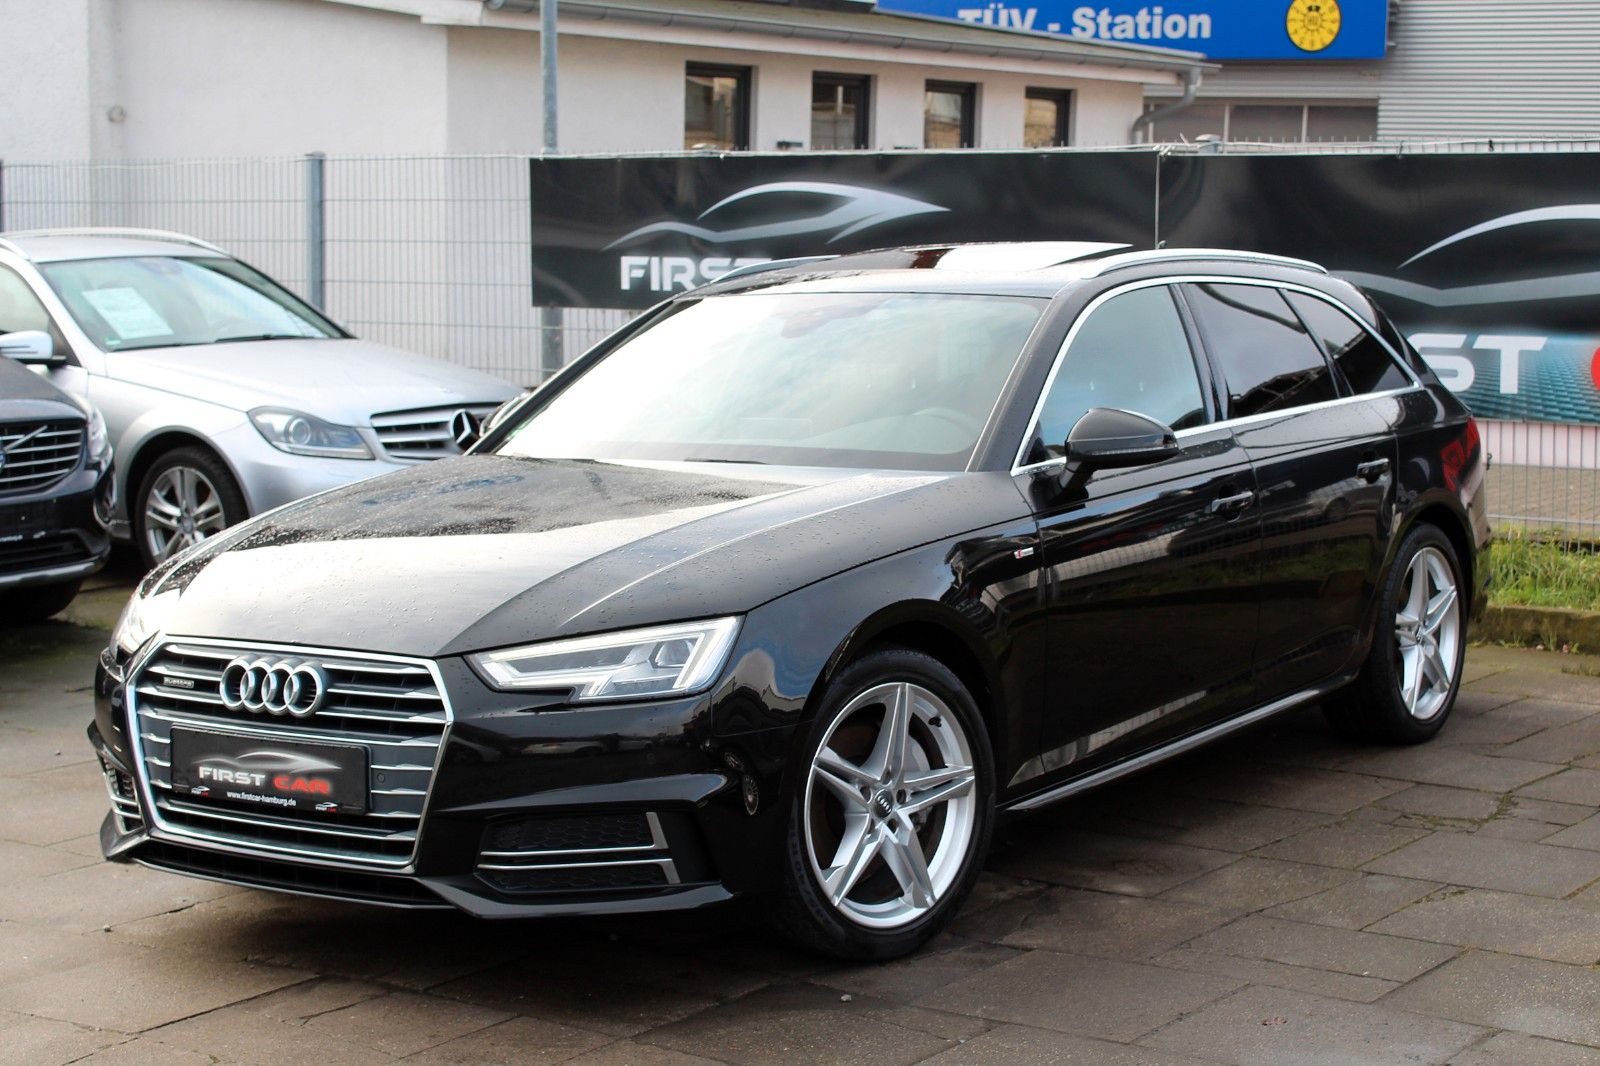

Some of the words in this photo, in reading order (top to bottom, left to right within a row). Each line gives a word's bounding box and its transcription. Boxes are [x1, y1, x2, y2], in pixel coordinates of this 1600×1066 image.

[1071, 7, 1212, 40] Station
[199, 766, 266, 786] FIRST
[273, 776, 330, 794] CAR
